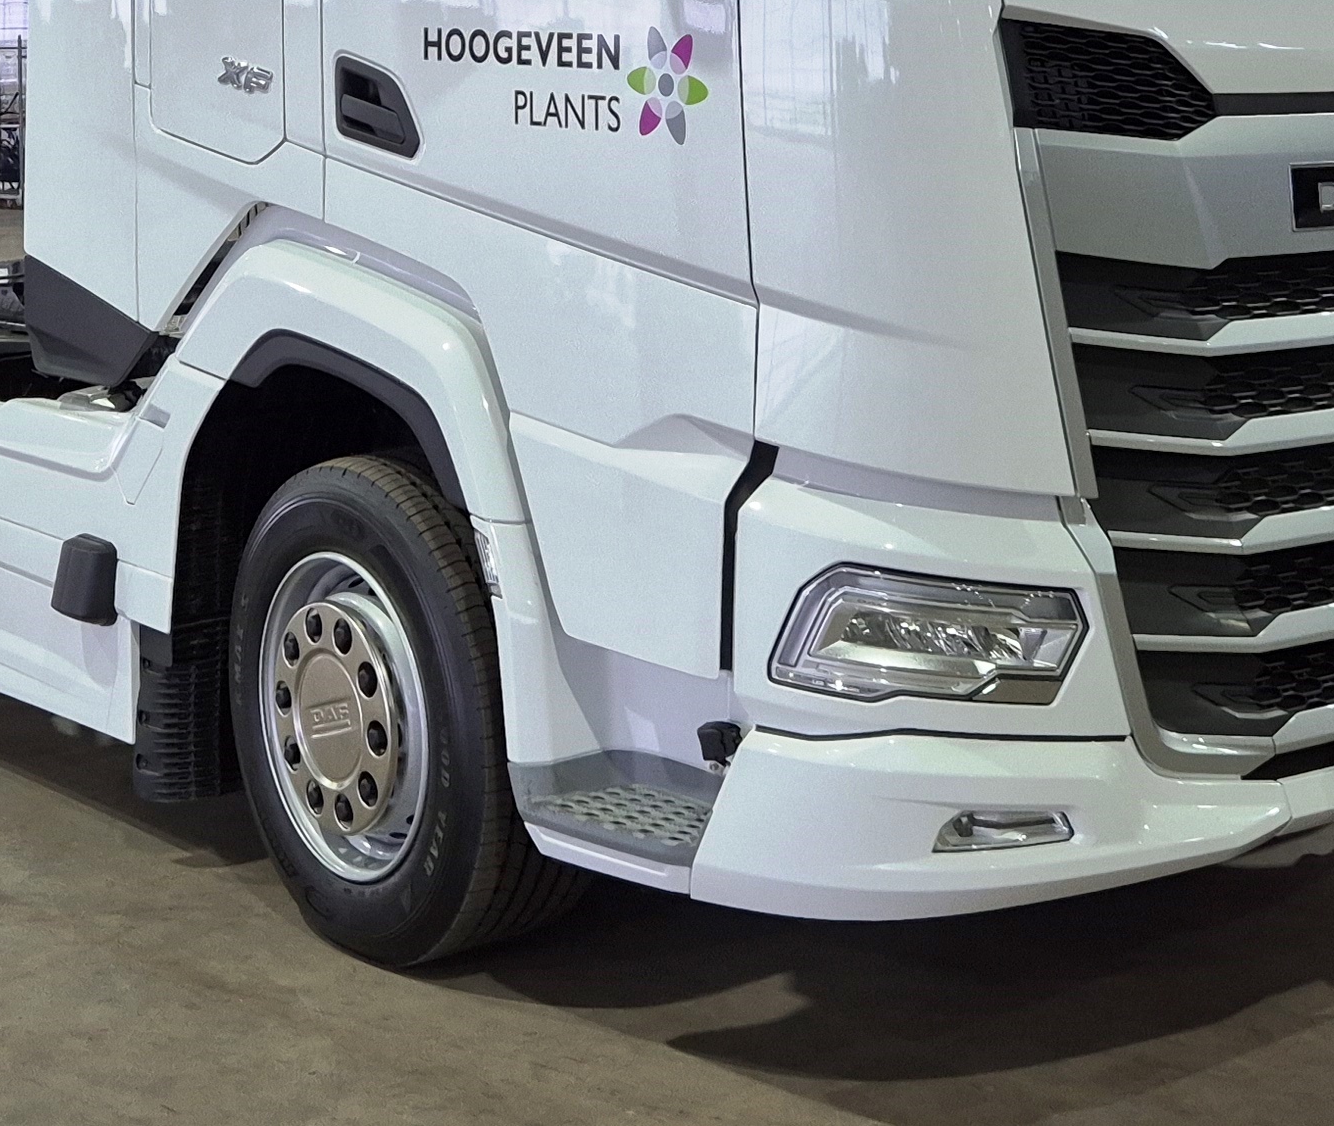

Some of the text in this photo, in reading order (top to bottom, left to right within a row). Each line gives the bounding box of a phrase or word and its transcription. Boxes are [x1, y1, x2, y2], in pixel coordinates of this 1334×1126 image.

[423, 27, 621, 71] HOOGEVEEN
[514, 89, 621, 132] PLANTS
[310, 702, 350, 723] DAF
